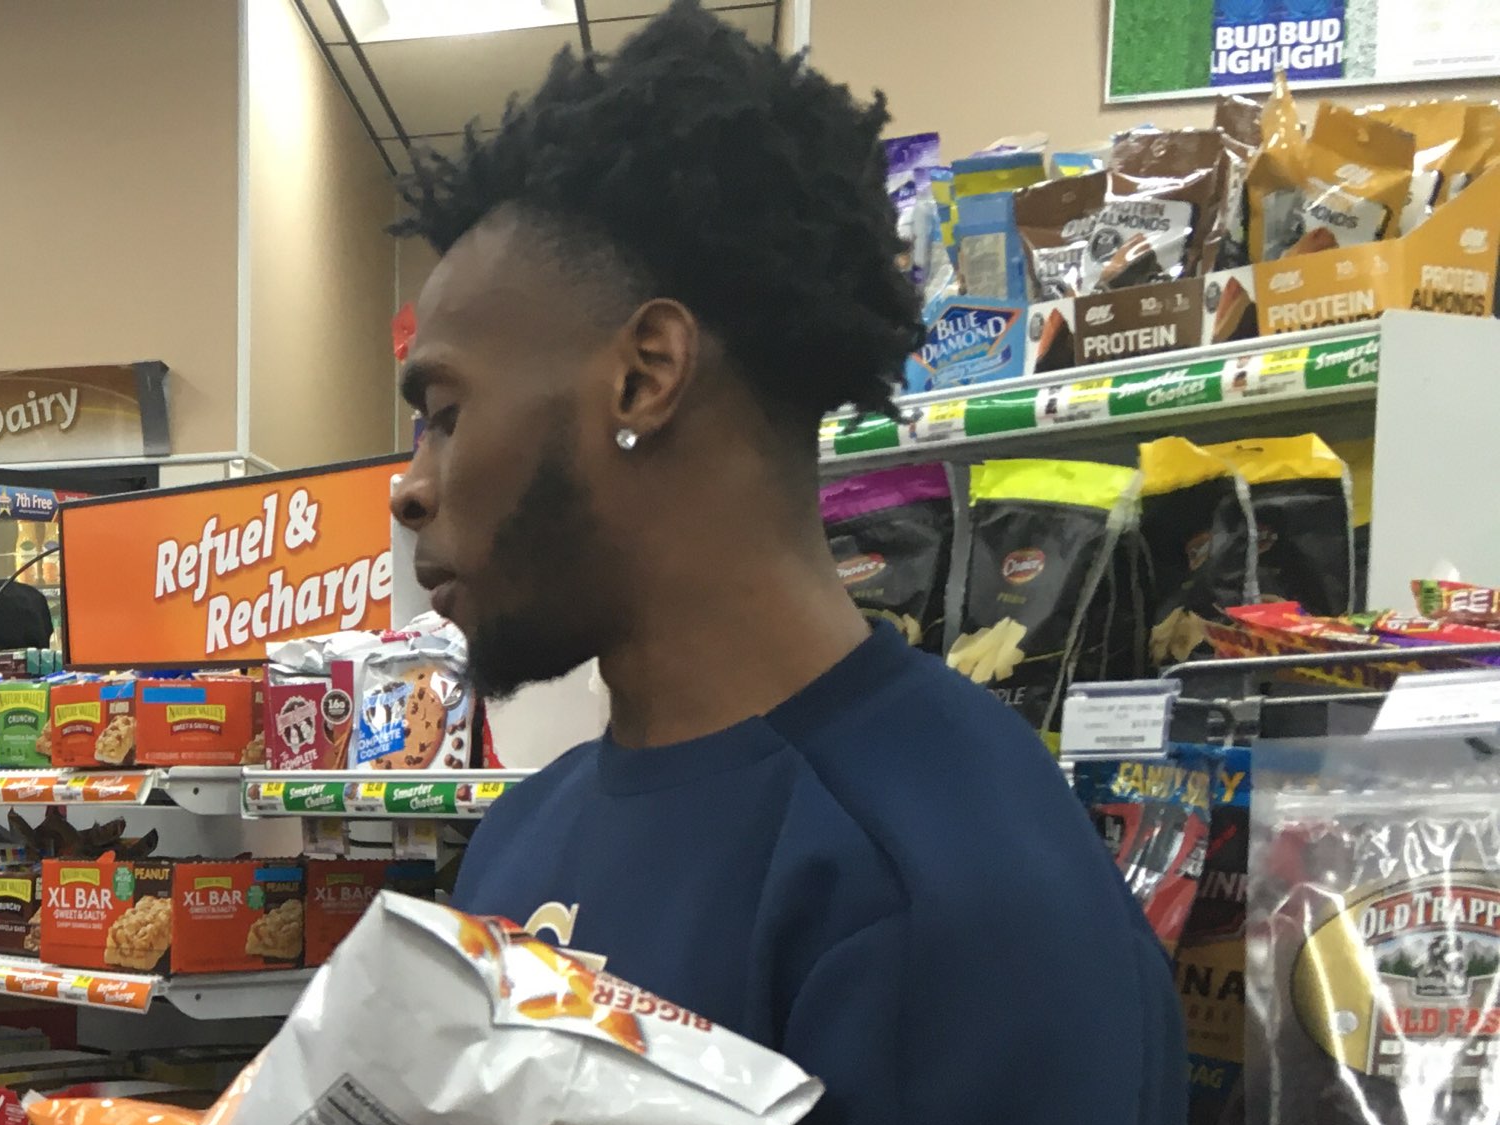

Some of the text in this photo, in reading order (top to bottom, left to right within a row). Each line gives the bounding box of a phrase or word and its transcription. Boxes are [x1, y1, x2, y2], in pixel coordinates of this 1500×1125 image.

[1216, 18, 1341, 50] BUD BUD
[1420, 264, 1490, 292] PROTEIN
[1269, 289, 1375, 328] PROTEIN
[937, 310, 981, 341] BLUE
[922, 316, 1006, 364] DIAMOND
[1084, 323, 1177, 358] PROTEIN
[1145, 379, 1207, 406] Choices
[15, 493, 53, 511] 7th Free
[155, 488, 320, 601] Refuel &
[205, 547, 392, 654] Recharge
[289, 783, 325, 800] Smarter
[304, 792, 336, 810] Choices
[392, 783, 435, 801] Smarter
[409, 793, 444, 811] Choices
[135, 868, 170, 880] PEANUT
[47, 887, 113, 910] XL BAR
[183, 890, 243, 906] XL BAR
[315, 886, 375, 901] XL BAR
[1359, 890, 1500, 939] OLD TRAPP
